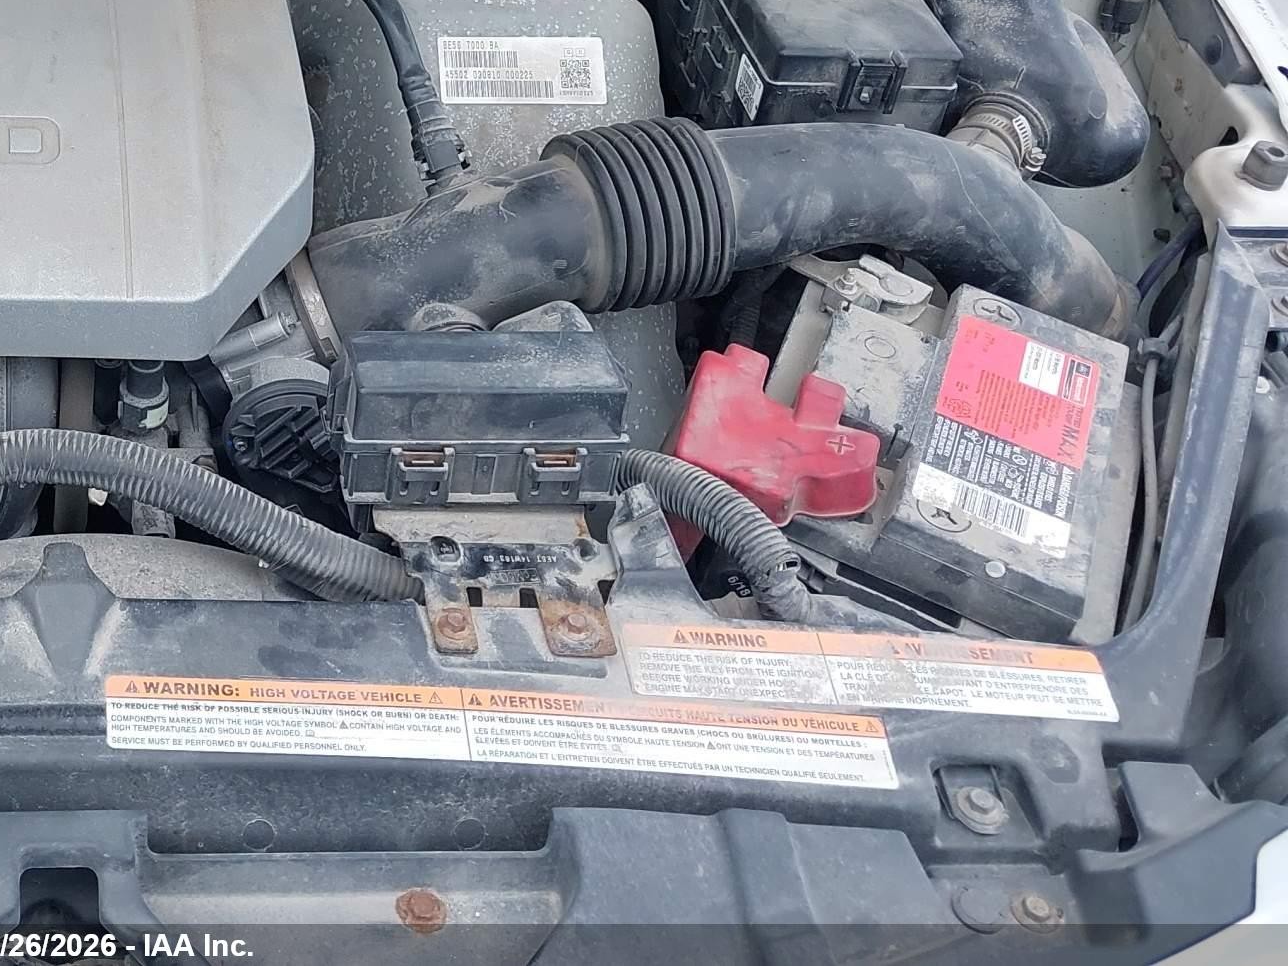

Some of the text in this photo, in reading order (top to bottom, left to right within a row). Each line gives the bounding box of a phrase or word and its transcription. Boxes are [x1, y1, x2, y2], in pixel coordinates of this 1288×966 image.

[688, 632, 768, 647] WARNING
[694, 654, 713, 663] THE
[739, 656, 754, 665] OF
[835, 660, 866, 670] POUR
[639, 662, 681, 672] REMOVE
[682, 664, 702, 673] THE
[704, 665, 724, 674] KEY
[755, 667, 775, 676] THE
[683, 674, 730, 684] WORKING
[838, 670, 853, 680] LA
[1068, 686, 1089, 696] DES
[142, 680, 423, 703] WARNING: HIGH VOLTAGE VEHICLE
[969, 689, 984, 698] LE
[984, 690, 1025, 701] MOTEUR
[1025, 693, 1051, 703] PEUT
[1065, 696, 1104, 707] METTRE
[124, 701, 159, 710] REDUCE
[162, 703, 178, 711] THE
[181, 703, 201, 711] RISK
[204, 704, 214, 712] OF
[217, 705, 259, 714] POSSIBLE
[262, 706, 299, 715] SERIOUS
[300, 708, 333, 716] INJURY
[370, 710, 382, 718] OR
[413, 712, 426, 720] OR
[428, 712, 459, 721] DEATH:
[110, 713, 461, 733] COMPONENTS MARKED WITH THE HIGH VOLTAGE SYMBOL CONTAIN HIGH VOLTAGE AND
[111, 723, 303, 737] HIGH TEMPERATURES AND SHOULD BE AVOIDED.
[728, 712, 778, 726] TENSION
[781, 716, 799, 727] DU
[800, 717, 859, 731] VÉHICULE
[471, 714, 496, 723] POUR
[537, 718, 555, 727] LES
[556, 720, 594, 729] RISQUES
[595, 722, 607, 730] DE
[609, 723, 660, 734] BLESSURES
[661, 727, 695, 736] GRAVES
[696, 729, 730, 739] (CHOCS
[731, 731, 744, 740] OU
[795, 736, 809, 744] OU
[810, 737, 862, 748] MORTELLES
[111, 735, 367, 752] SERVICE MUST BE PERFORMED BY QUALIFIED PERSONNEL ONLY.
[473, 726, 489, 734] LES
[606, 735, 643, 745] SYMBOLE
[643, 737, 671, 747] HAUTE
[671, 739, 705, 749] TENSION
[714, 742, 732, 751] ONT
[733, 743, 749, 752] UNE
[750, 745, 784, 755] TENSION
[785, 747, 795, 756] ET
[796, 748, 813, 757] DES
[510, 737, 522, 745] ET
[522, 738, 556, 748] DOIVENT
[476, 747, 487, 756] LA
[538, 752, 549, 760] ET
[550, 752, 600, 764] L'ENTRETIEN
[601, 756, 635, 766] DOIVENT
[704, 763, 720, 772] PAR
[721, 764, 733, 773] UN
[733, 765, 780, 776] TECHNICIEN
